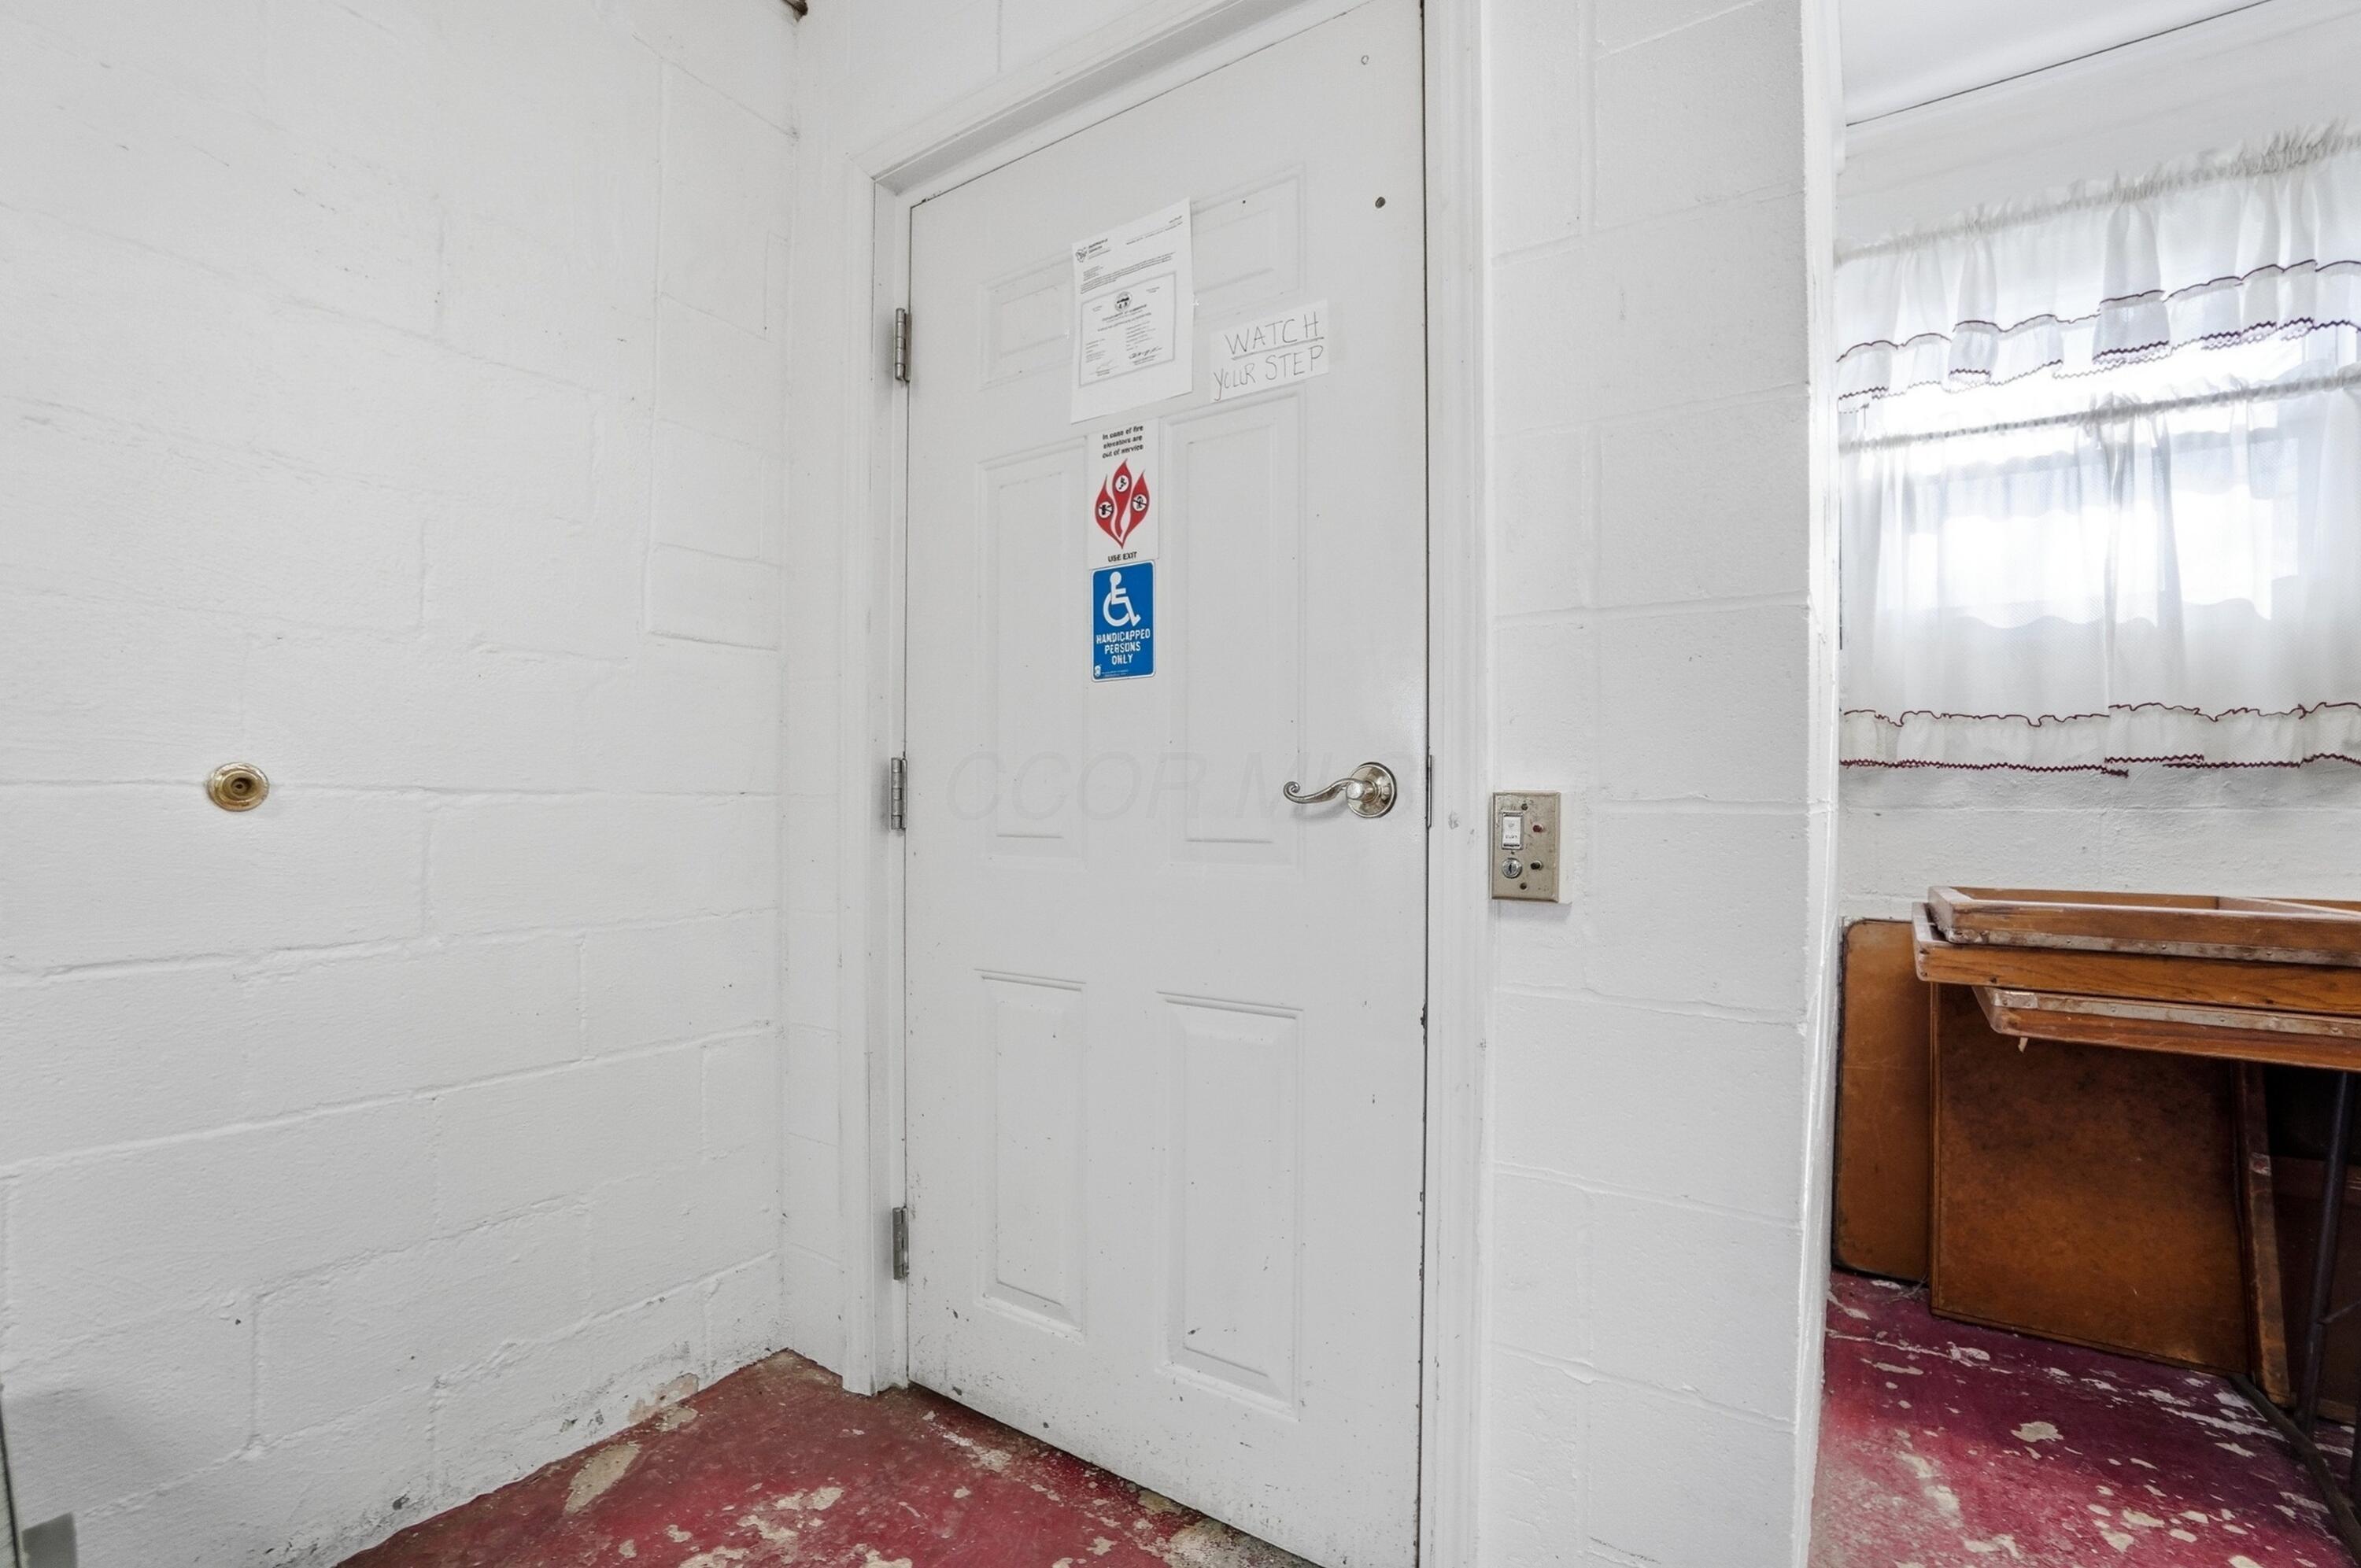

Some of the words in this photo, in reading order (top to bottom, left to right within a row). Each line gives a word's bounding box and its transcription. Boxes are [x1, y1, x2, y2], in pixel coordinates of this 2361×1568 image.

[1224, 311, 1319, 355] WATCH
[1265, 345, 1324, 381] STEP
[1103, 437, 1131, 449] elevators
[1107, 553, 1121, 563] USE
[1123, 552, 1137, 561] EXIT
[1096, 629, 1151, 644] HANDICAPPED
[1104, 641, 1141, 655] PERSONS
[1111, 654, 1134, 666] ONLY
